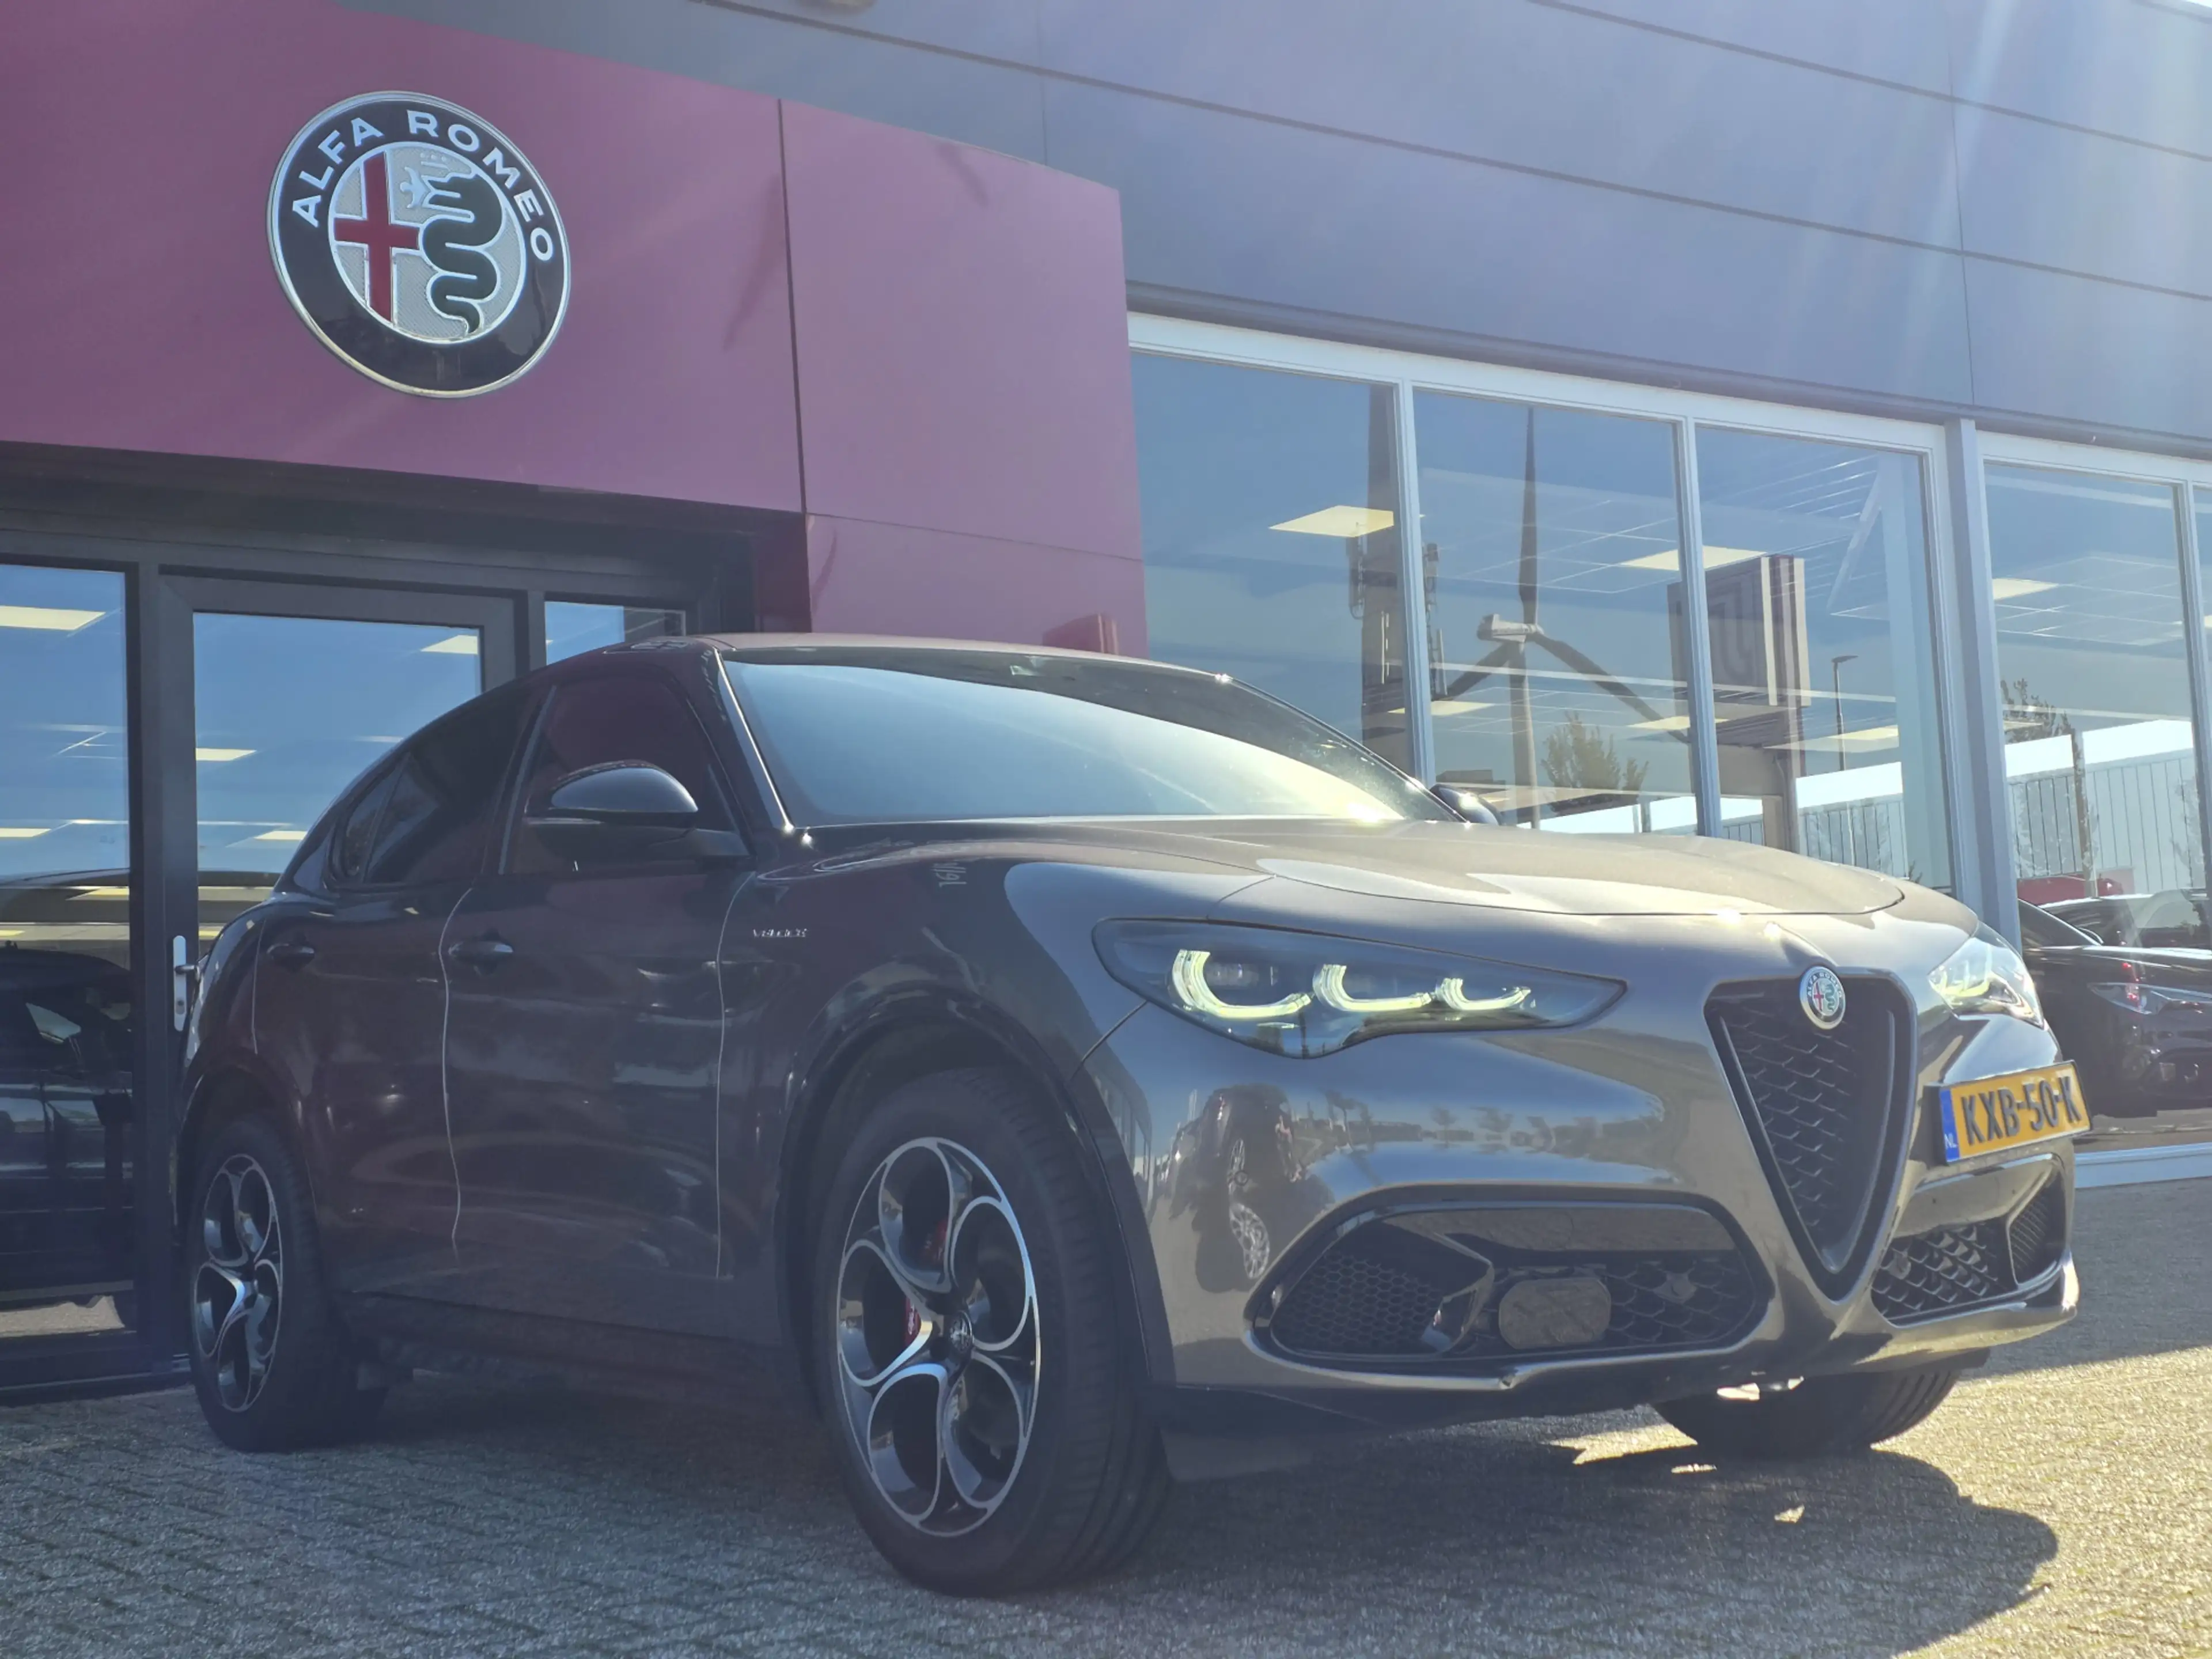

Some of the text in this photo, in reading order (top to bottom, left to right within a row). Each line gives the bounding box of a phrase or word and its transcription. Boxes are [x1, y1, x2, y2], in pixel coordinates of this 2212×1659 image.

[292, 109, 554, 262] ALFA ROMEO
[1944, 1133, 1957, 1150] NL
[1961, 1075, 2082, 1146] KXB-50-K
